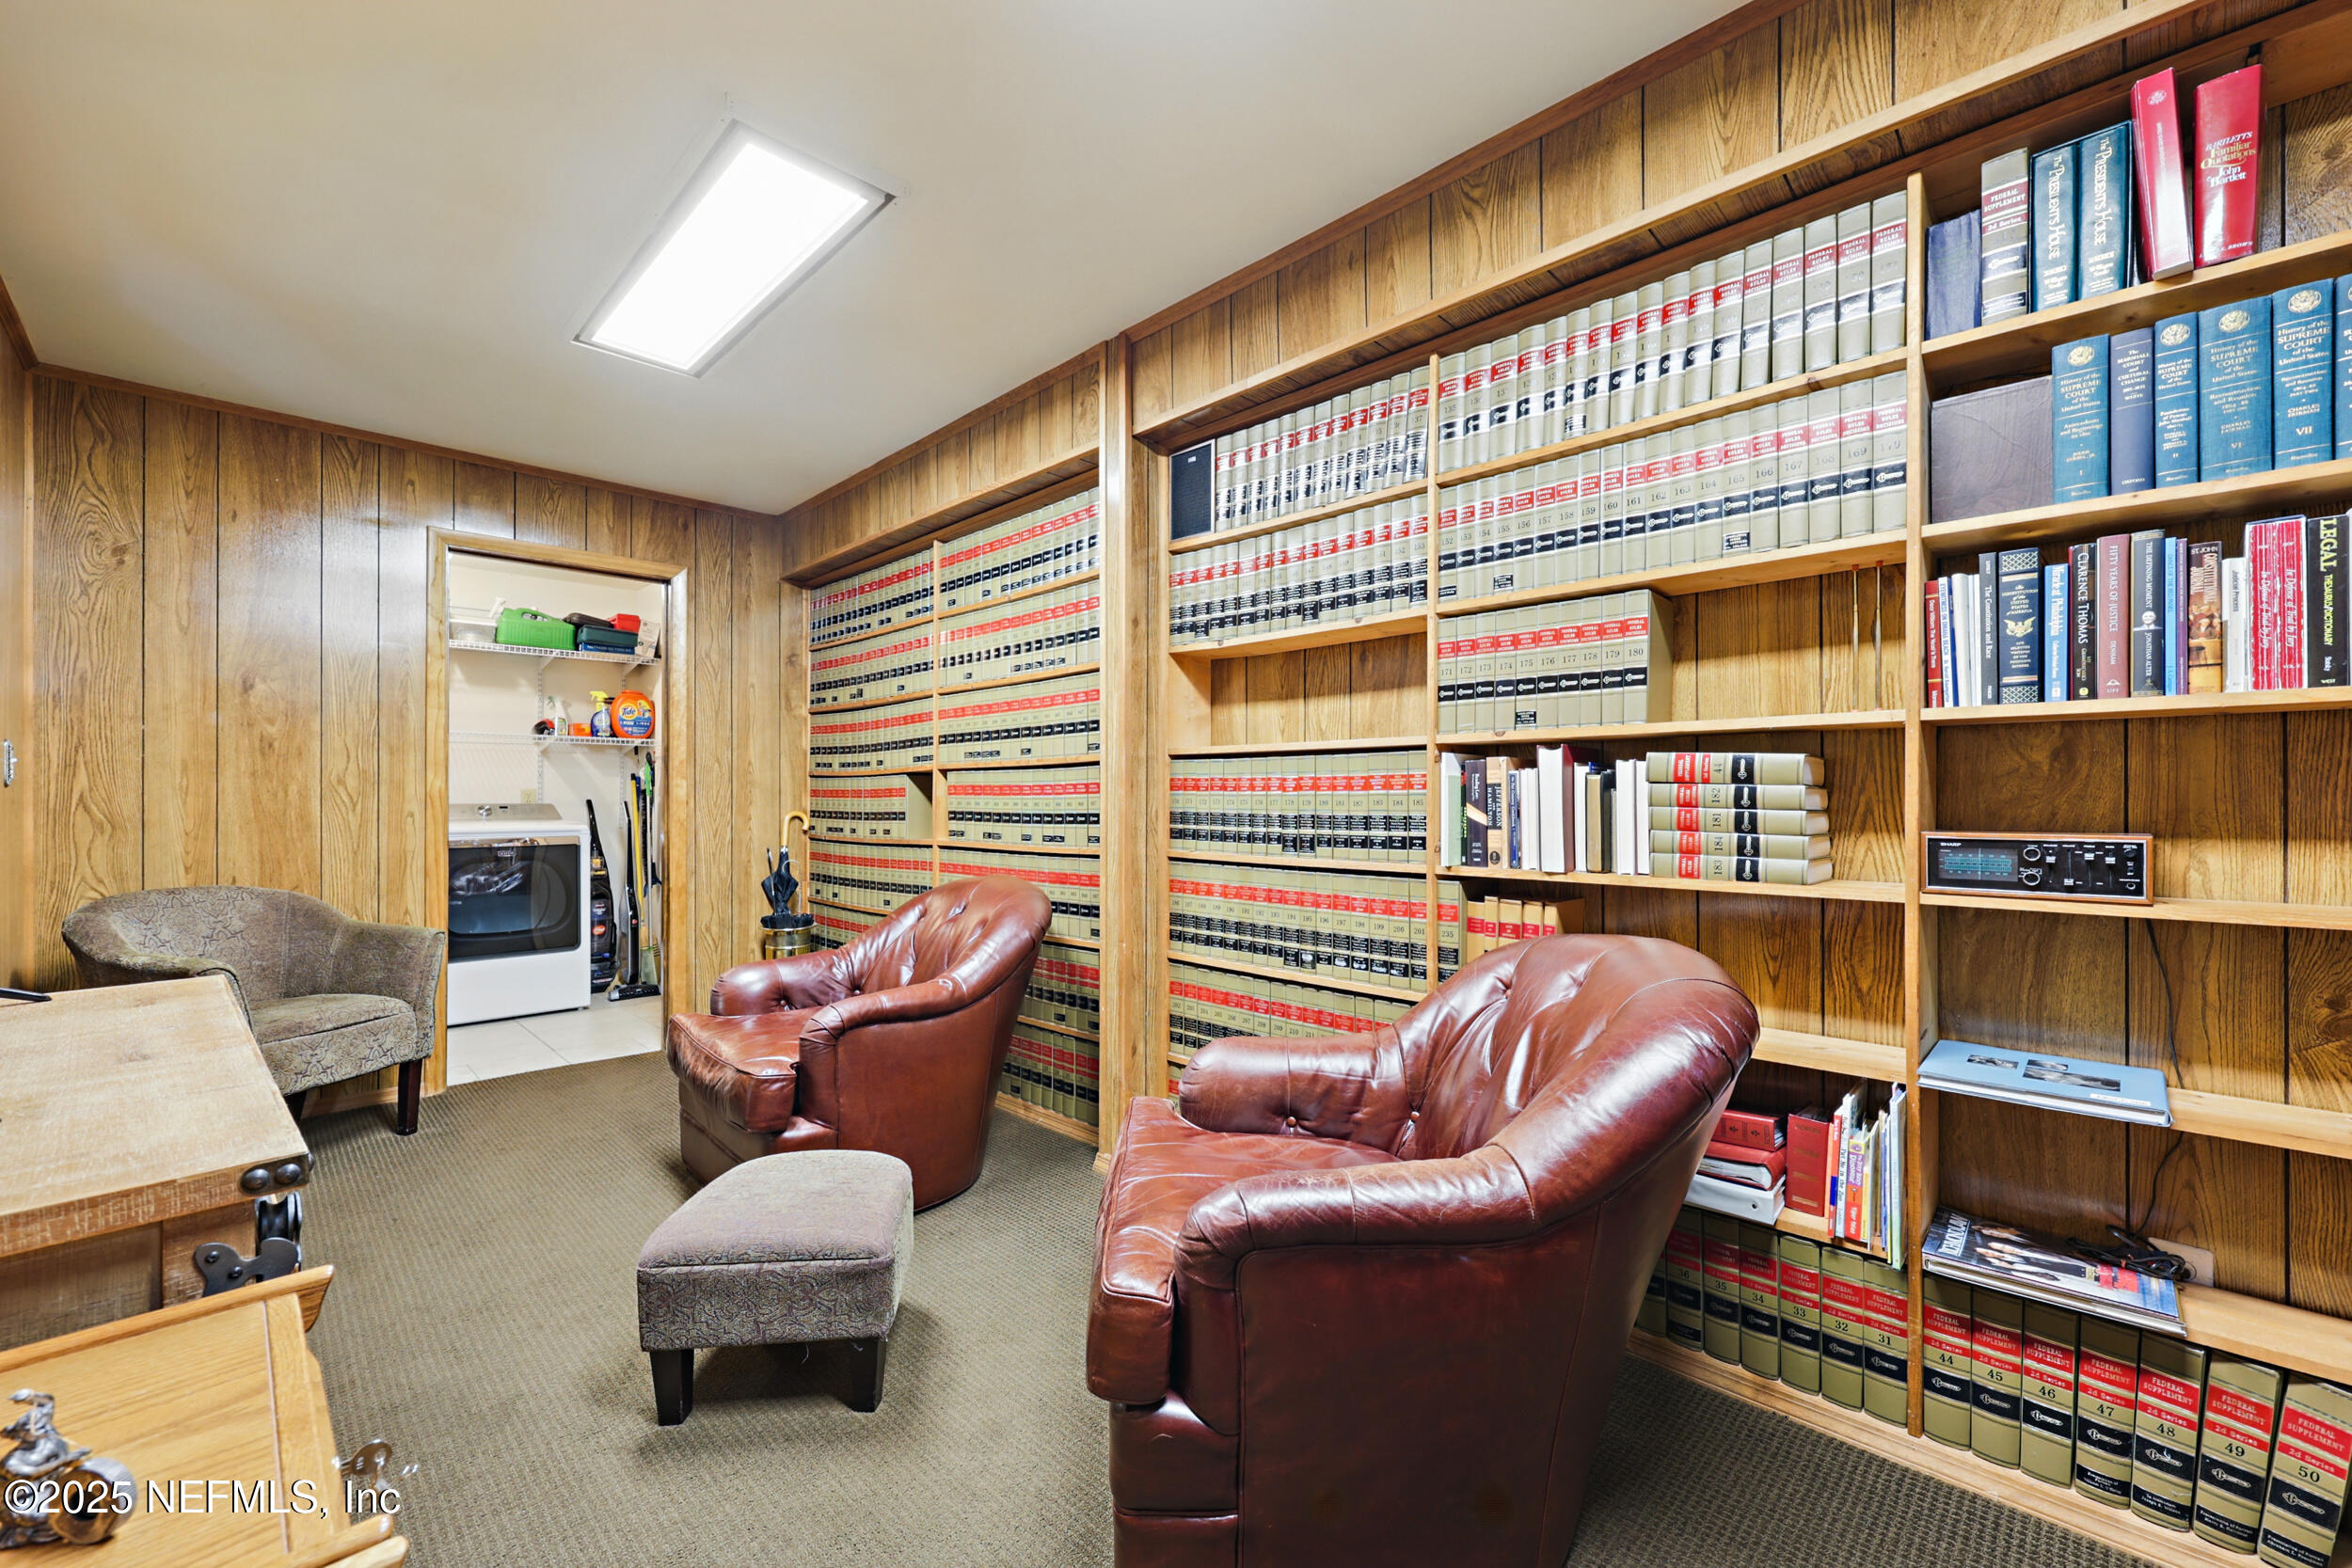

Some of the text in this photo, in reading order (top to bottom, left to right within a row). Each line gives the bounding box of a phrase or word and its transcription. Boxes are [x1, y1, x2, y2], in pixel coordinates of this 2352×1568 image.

[2211, 141, 2251, 158] Familiar
[2201, 148, 2257, 169] Quotations
[2217, 166, 2241, 177] John
[2209, 172, 2247, 187] Bartlett
[1991, 188, 2018, 203] FEDERAL
[1984, 194, 2026, 213] SUPPLEMENT
[1876, 227, 1903, 238] FEDERAL
[1881, 233, 1899, 243] RULES
[1843, 238, 1866, 249] FEDERAL
[1808, 248, 1833, 261] FEDERAL
[2277, 327, 2330, 344] SUPREME
[2278, 327, 2306, 337] History
[2283, 337, 2324, 351] COURT
[2117, 353, 2151, 364] MARSHALL
[2210, 346, 2259, 362] SUPREME
[2279, 351, 2329, 366] United States
[2122, 359, 2144, 369] COURT
[2157, 363, 2192, 374] SUPREME
[2216, 356, 2252, 369] COURT
[2118, 371, 2149, 381] CULTURAL
[2121, 376, 2146, 386] CHANGE
[2162, 370, 2189, 380] COURT
[2212, 370, 2258, 383] United States
[2060, 377, 2082, 386] History
[2060, 380, 2101, 393] SUPREME
[2065, 387, 2096, 399] COURT
[2061, 404, 2080, 412] United
[1844, 414, 1867, 422] FEDERAL
[2296, 426, 2313, 436] VII
[1848, 448, 1867, 459] 169
[1756, 469, 1773, 479] 166
[1627, 497, 1641, 506] 161
[1651, 491, 1666, 502] 162
[1581, 506, 1596, 516] 159
[1603, 501, 1618, 512] 160
[1560, 511, 1573, 521] 158
[2319, 518, 2339, 572] LEGAL
[2109, 545, 2118, 565] FIFTY
[2109, 566, 2118, 590] YEARS
[2190, 566, 2203, 594] JOURNAL
[2203, 553, 2217, 604] CONSTITUTIONAL
[2285, 578, 2296, 600] Defense
[2077, 552, 2090, 643] CLARENCE THOMAS
[2109, 591, 2118, 601] OF
[2324, 574, 2333, 646] THESAURUS/DICTIONARY
[2108, 603, 2118, 632] JUSTICE
[2285, 635, 2296, 647] Jury
[1583, 652, 1597, 660] 178
[1605, 649, 1620, 658] 179
[1629, 648, 1644, 657] 180
[1520, 658, 1534, 668] 175
[1562, 655, 1577, 664] 177
[1460, 666, 1472, 674] 172
[1479, 663, 1491, 672] 173
[1500, 662, 1512, 671] 174
[621, 707, 636, 717] Tide
[1712, 788, 1721, 803] 182
[1712, 813, 1722, 827] 181
[1392, 925, 1405, 934] 200
[1413, 927, 1425, 936] 201
[1441, 929, 1454, 939] 235
[1849, 1154, 1858, 1184] Dinosaur
[1716, 1280, 1726, 1291] 35
[1831, 1283, 1853, 1294] FEDERAL
[1753, 1292, 1764, 1303] 34
[1825, 1289, 1859, 1303] SUPPLEMENT
[1872, 1294, 1897, 1307] FEDERAL
[1794, 1307, 1806, 1317] 33
[1867, 1300, 1903, 1316] SUPPLEMENT
[1933, 1313, 1959, 1325] FEDERAL
[1836, 1320, 1848, 1332] 32
[1928, 1319, 1966, 1335] SUPPLEMENT
[1879, 1334, 1891, 1345] 31
[1982, 1328, 2010, 1340] FEDERAL
[1941, 1343, 1963, 1354] Series
[1976, 1334, 2017, 1351] SUPPLEMENT
[2034, 1343, 2062, 1356] FEDERAL
[1939, 1354, 1953, 1365] 44
[2026, 1348, 2070, 1367] SUPPLEMENT
[1992, 1359, 2013, 1370] Series
[2091, 1359, 2122, 1374] FEDERAL
[1988, 1370, 2003, 1382] 45
[2042, 1375, 2066, 1387] Series
[2084, 1365, 2131, 1385] SUPPLEMENT
[2153, 1377, 2185, 1394] FEDERAL
[2040, 1386, 2056, 1399] 46
[2144, 1383, 2193, 1406] SUPPLEMENT
[2100, 1393, 2125, 1406] Series
[2221, 1395, 2257, 1414] FEDERAL
[2097, 1404, 2114, 1417] 47
[2147, 1406, 2187, 1427] 2d Series
[2213, 1400, 2266, 1426] SUPPLEMENT
[2156, 1423, 2175, 1437] 48
[2298, 1418, 2336, 1439] FEDERAL
[2215, 1425, 2258, 1446] 2d Series
[2288, 1423, 2345, 1452] SUPPLEMENT
[2225, 1443, 2245, 1457] 49
[2288, 1449, 2335, 1472] 2d Series
[2298, 1466, 2320, 1482] 50
